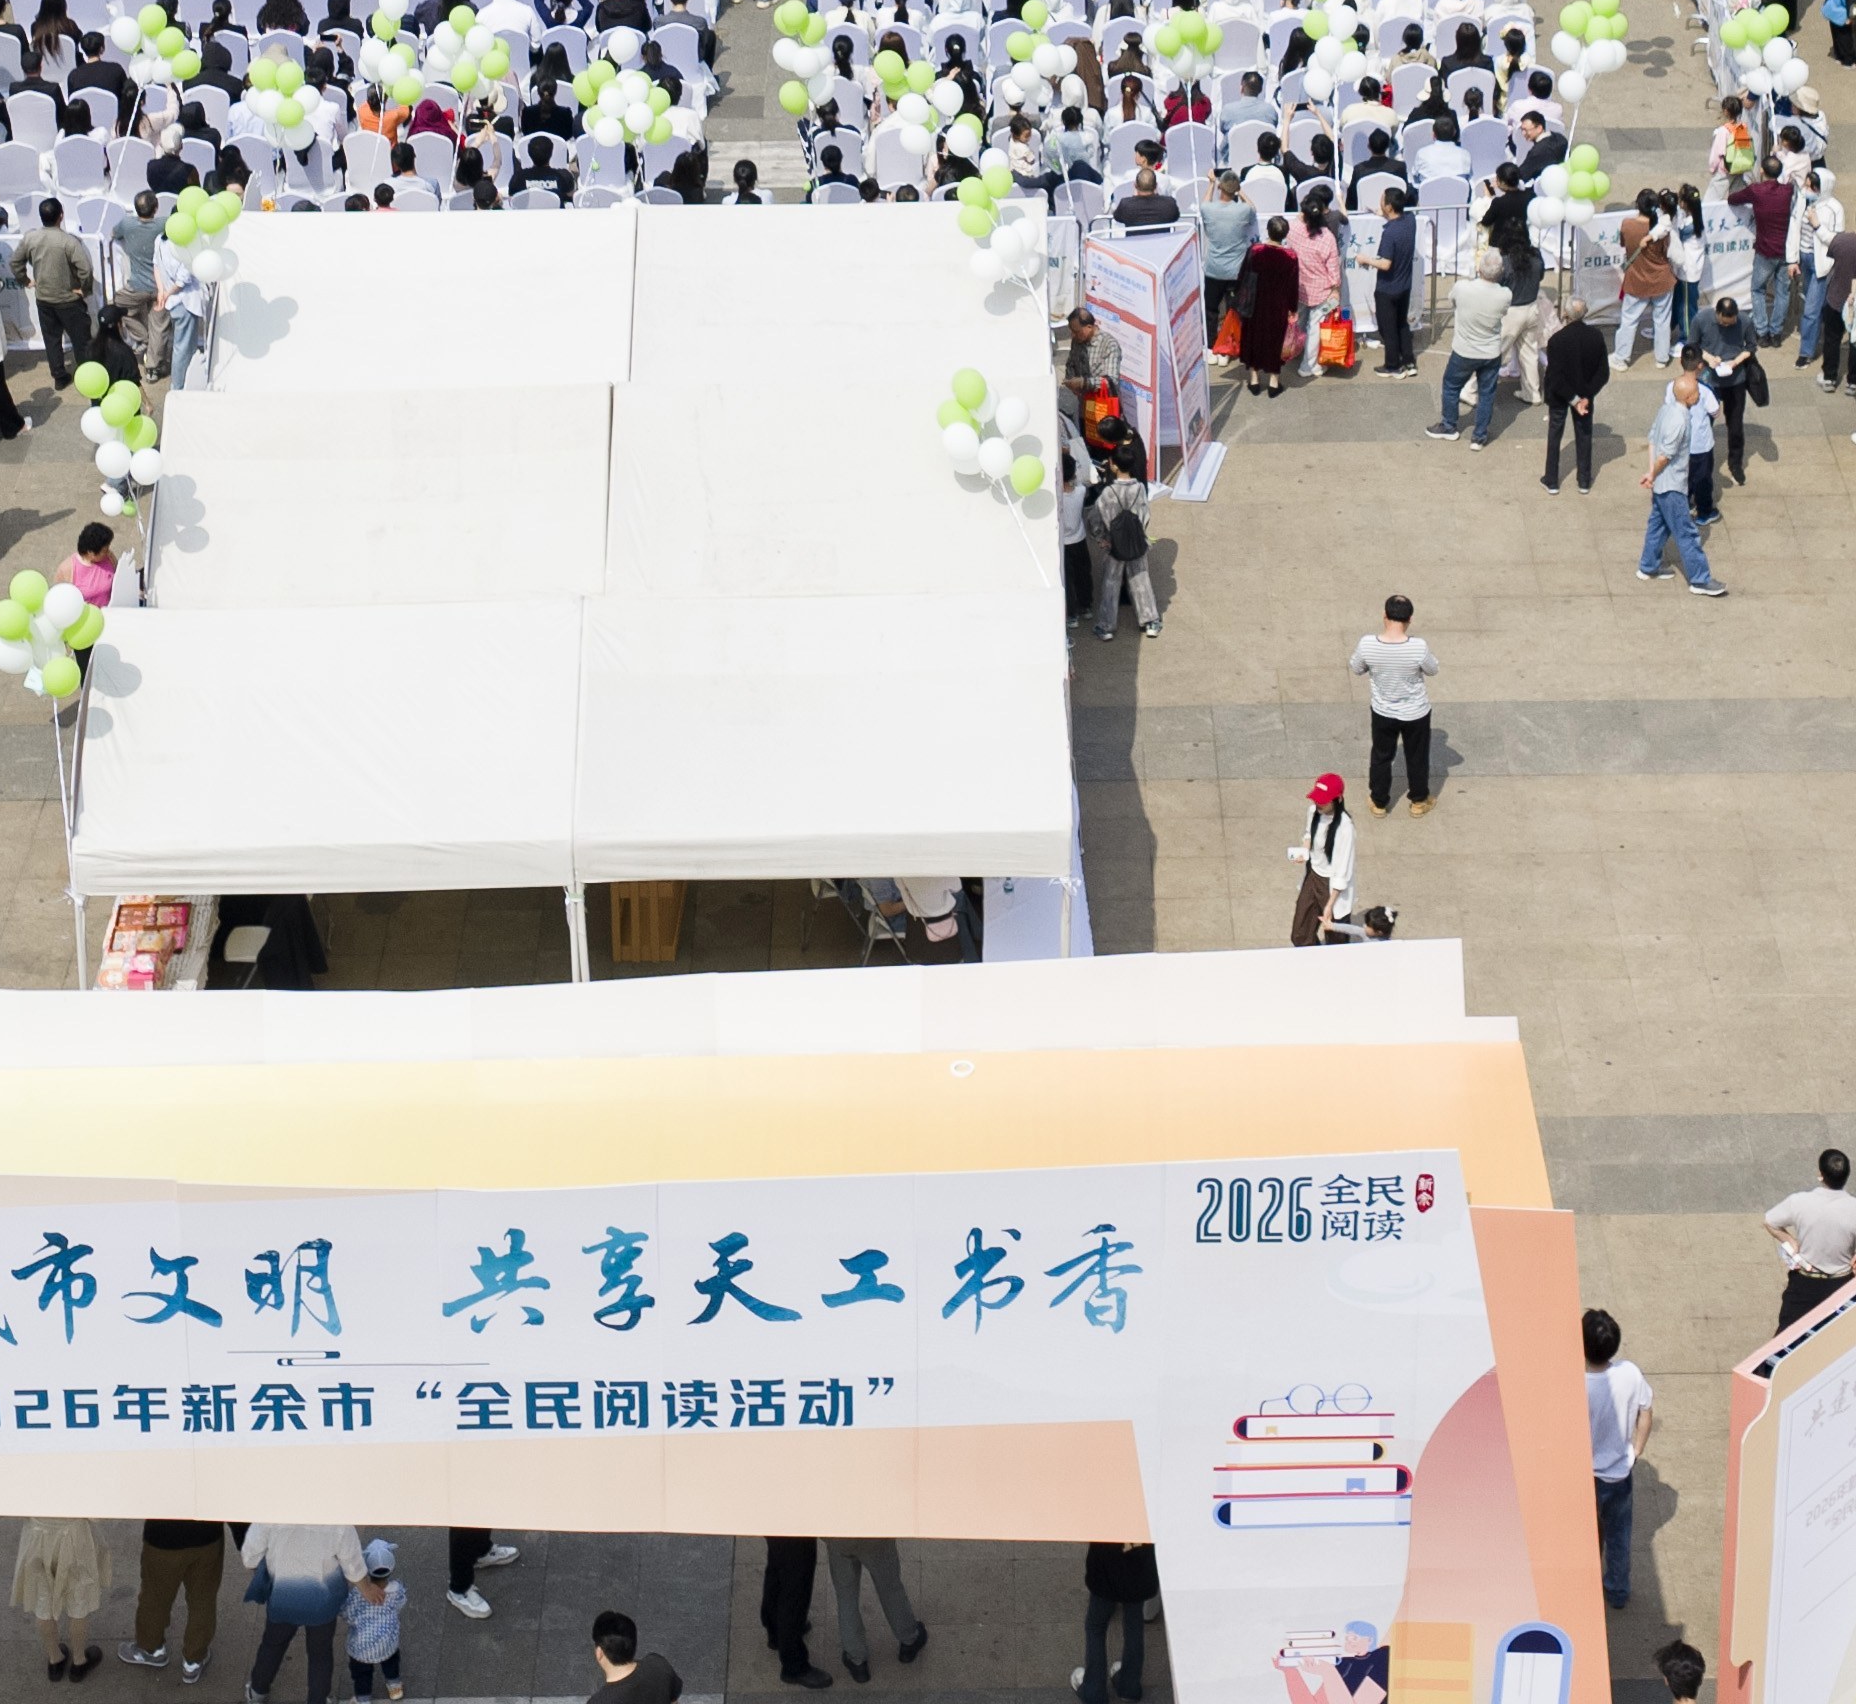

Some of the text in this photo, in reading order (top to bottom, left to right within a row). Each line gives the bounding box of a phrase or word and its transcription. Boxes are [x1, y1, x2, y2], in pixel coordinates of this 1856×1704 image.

[1196, 1177, 1313, 1243] 2026
[1320, 1173, 1406, 1207] 全民
[1321, 1209, 1406, 1242] 阅读
[443, 1224, 1145, 1335] 共享天工书香
